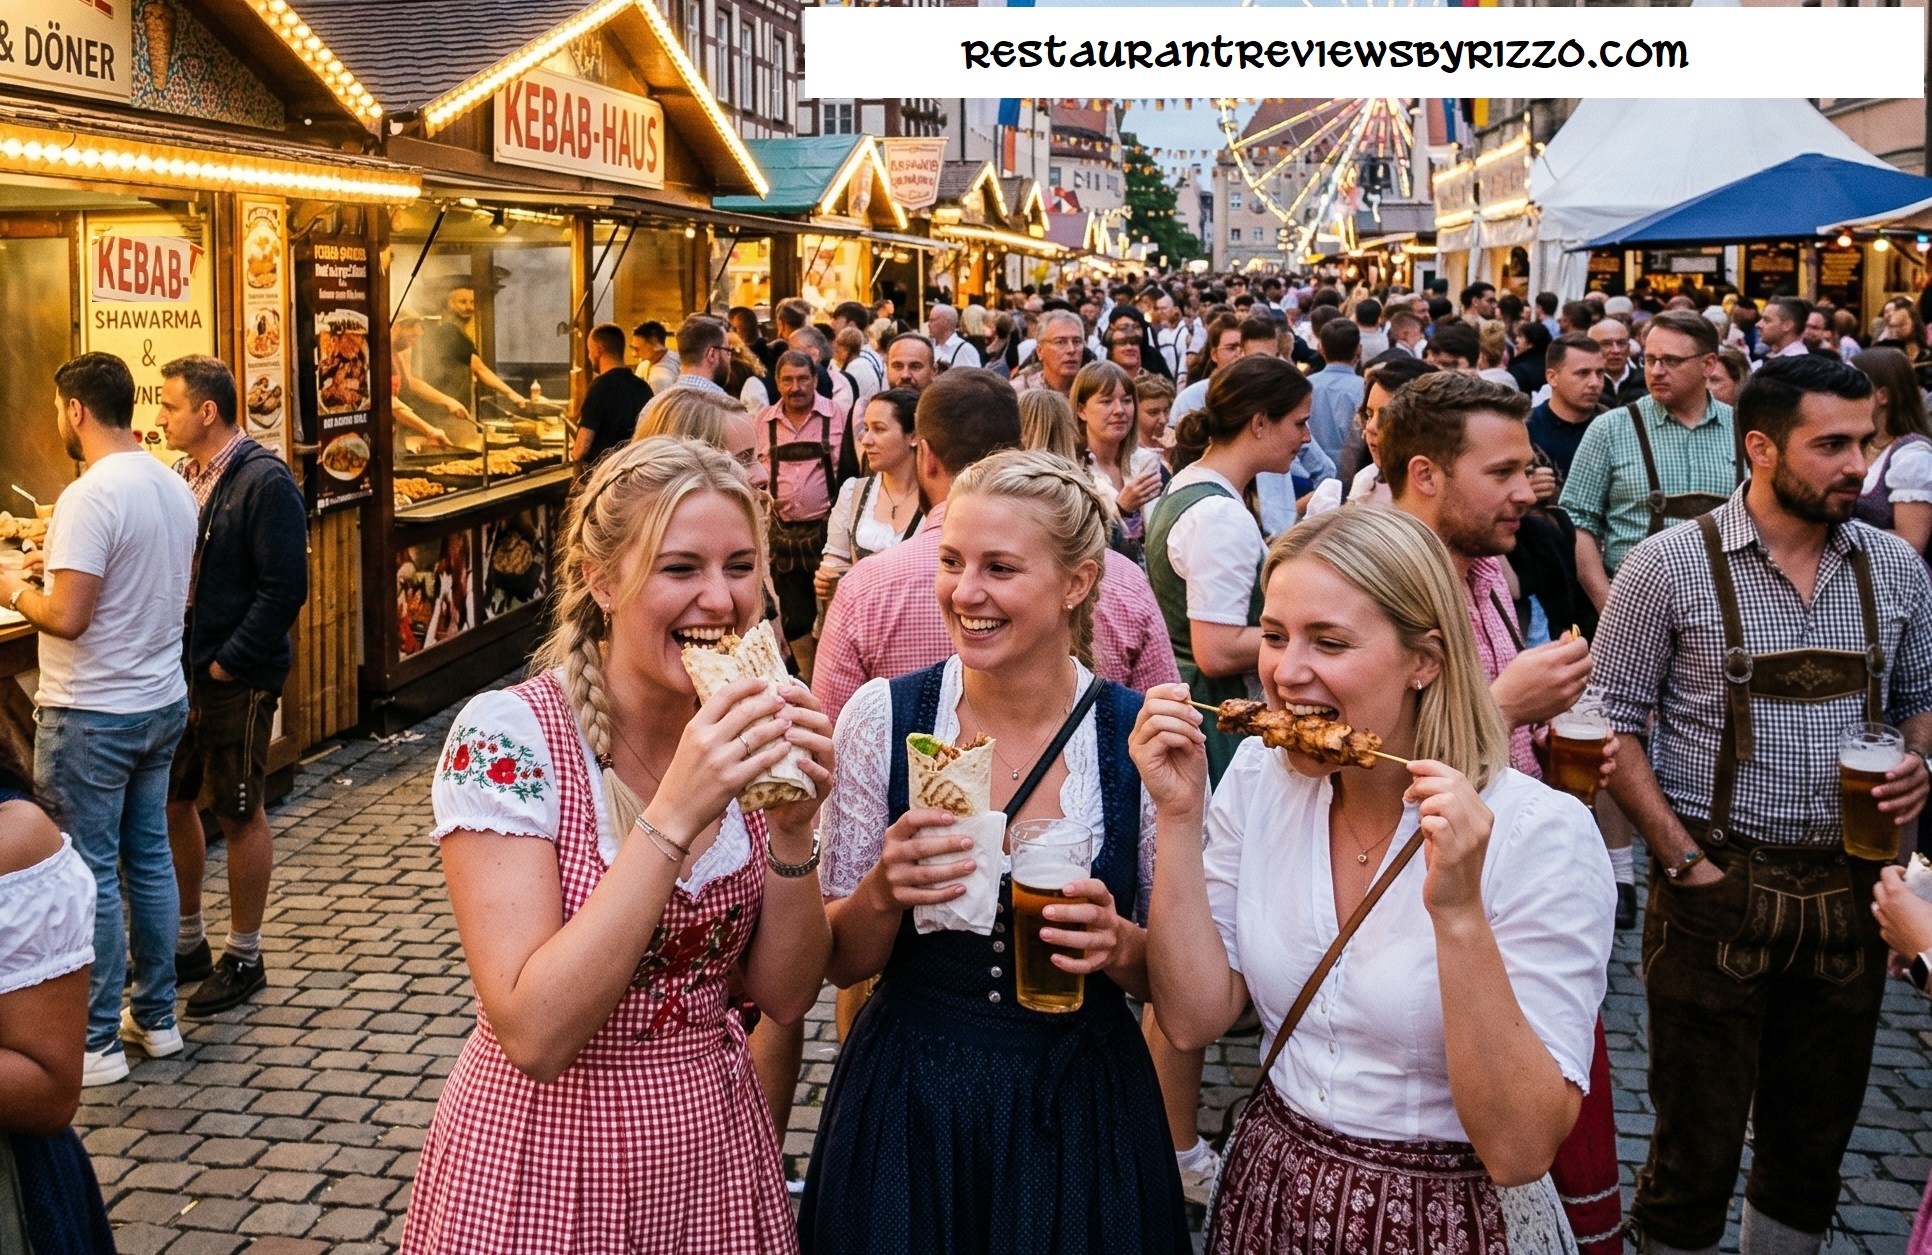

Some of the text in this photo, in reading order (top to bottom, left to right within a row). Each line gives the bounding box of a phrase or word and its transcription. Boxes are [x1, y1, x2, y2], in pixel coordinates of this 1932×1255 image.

[0, 20, 115, 81] & DÖNER
[505, 79, 657, 173] KEBAB-HAUS
[98, 236, 189, 299] KEBAB-
[95, 309, 202, 329] SHAWARMA
[141, 338, 156, 367] &
